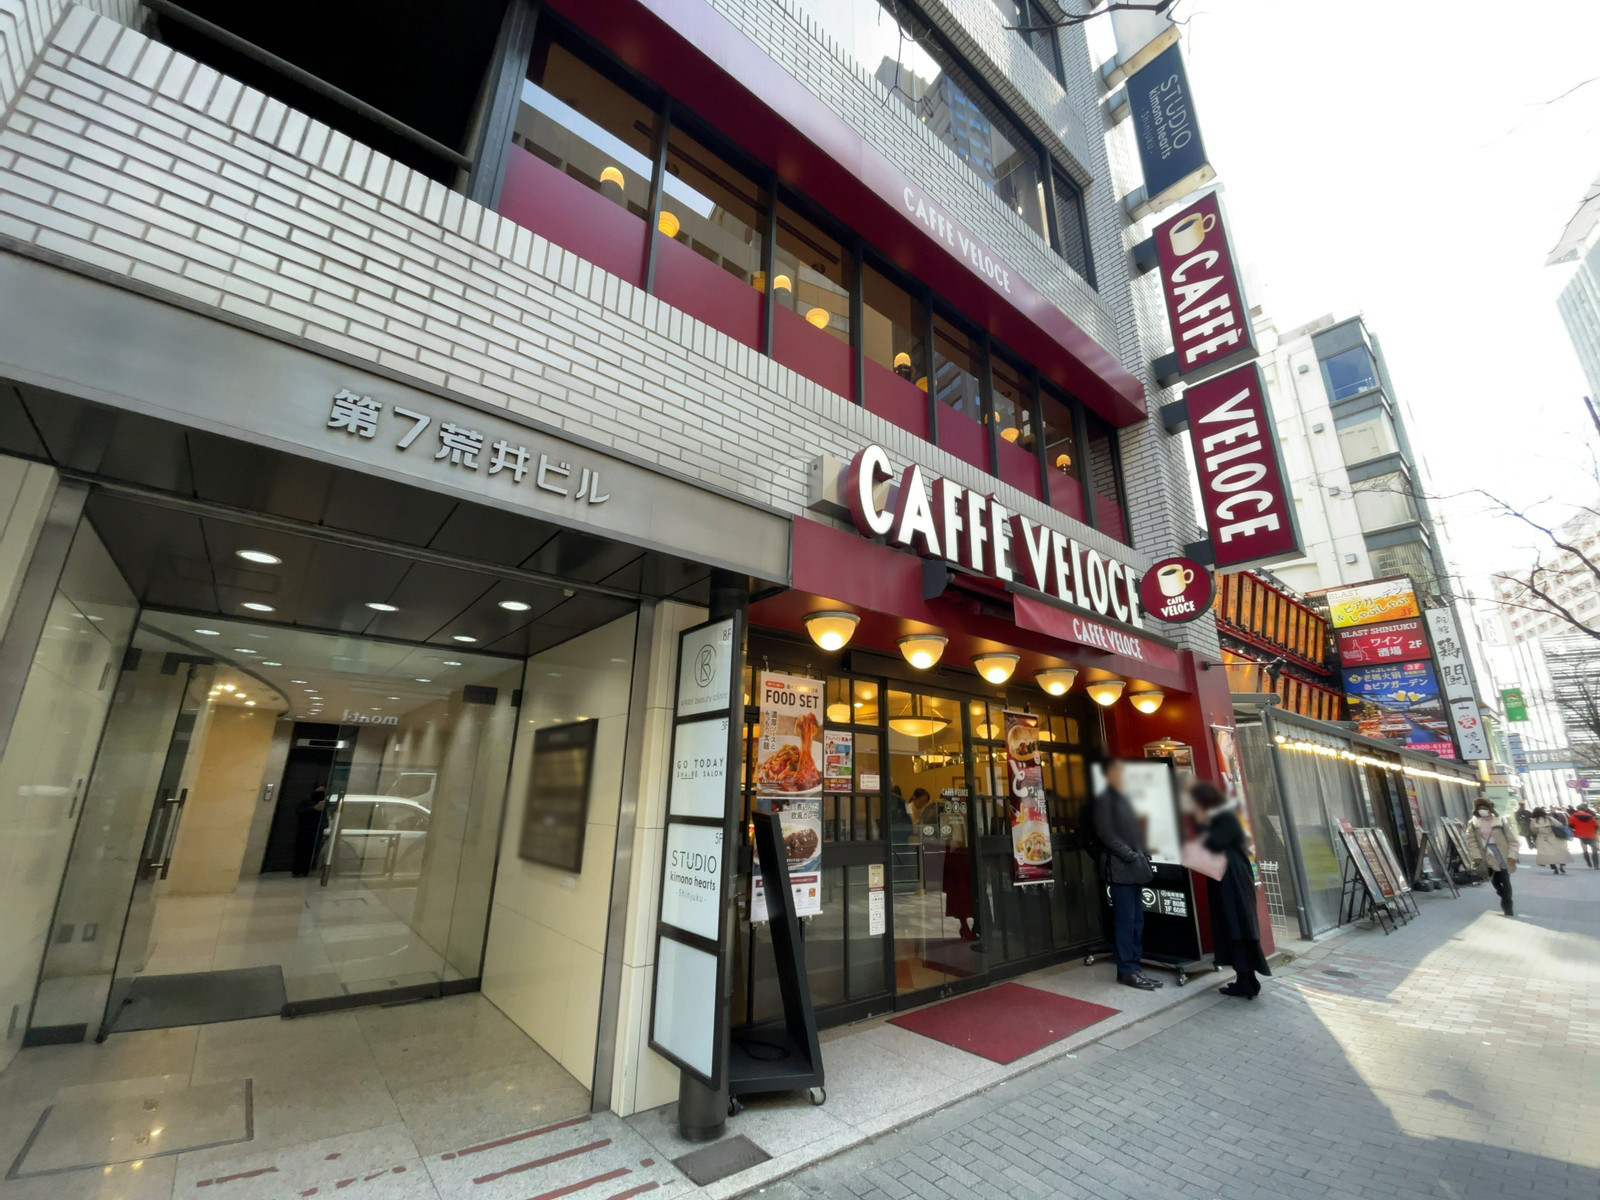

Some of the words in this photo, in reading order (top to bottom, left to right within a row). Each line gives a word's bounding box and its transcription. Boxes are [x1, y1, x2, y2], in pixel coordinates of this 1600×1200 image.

[1160, 74, 1192, 149] STUDIO
[1149, 85, 1163, 126] kimono
[1156, 122, 1171, 160] hearts
[957, 230, 1011, 294] VELOCE
[327, 388, 610, 504] 第7荒井ビル
[1198, 387, 1280, 544] VELOCE
[1012, 514, 1145, 630] VELOCE
[1160, 600, 1196, 618] VELOCE
[723, 628, 732, 641] 8F
[1341, 628, 1369, 639] BLAST
[1370, 622, 1417, 635] SHINJUKU
[1108, 628, 1144, 660] VELOCE
[1370, 636, 1403, 647] ワイン
[1377, 646, 1402, 657] 酒場
[1408, 639, 1423, 649] 2F
[765, 689, 796, 706] FOOD
[799, 694, 819, 709] SET
[677, 760, 689, 770] GO
[694, 757, 724, 770] TODAY
[714, 832, 723, 845] 5F
[671, 849, 717, 874] STUDIO
[670, 871, 693, 886] kimono
[694, 876, 716, 891] hearts
